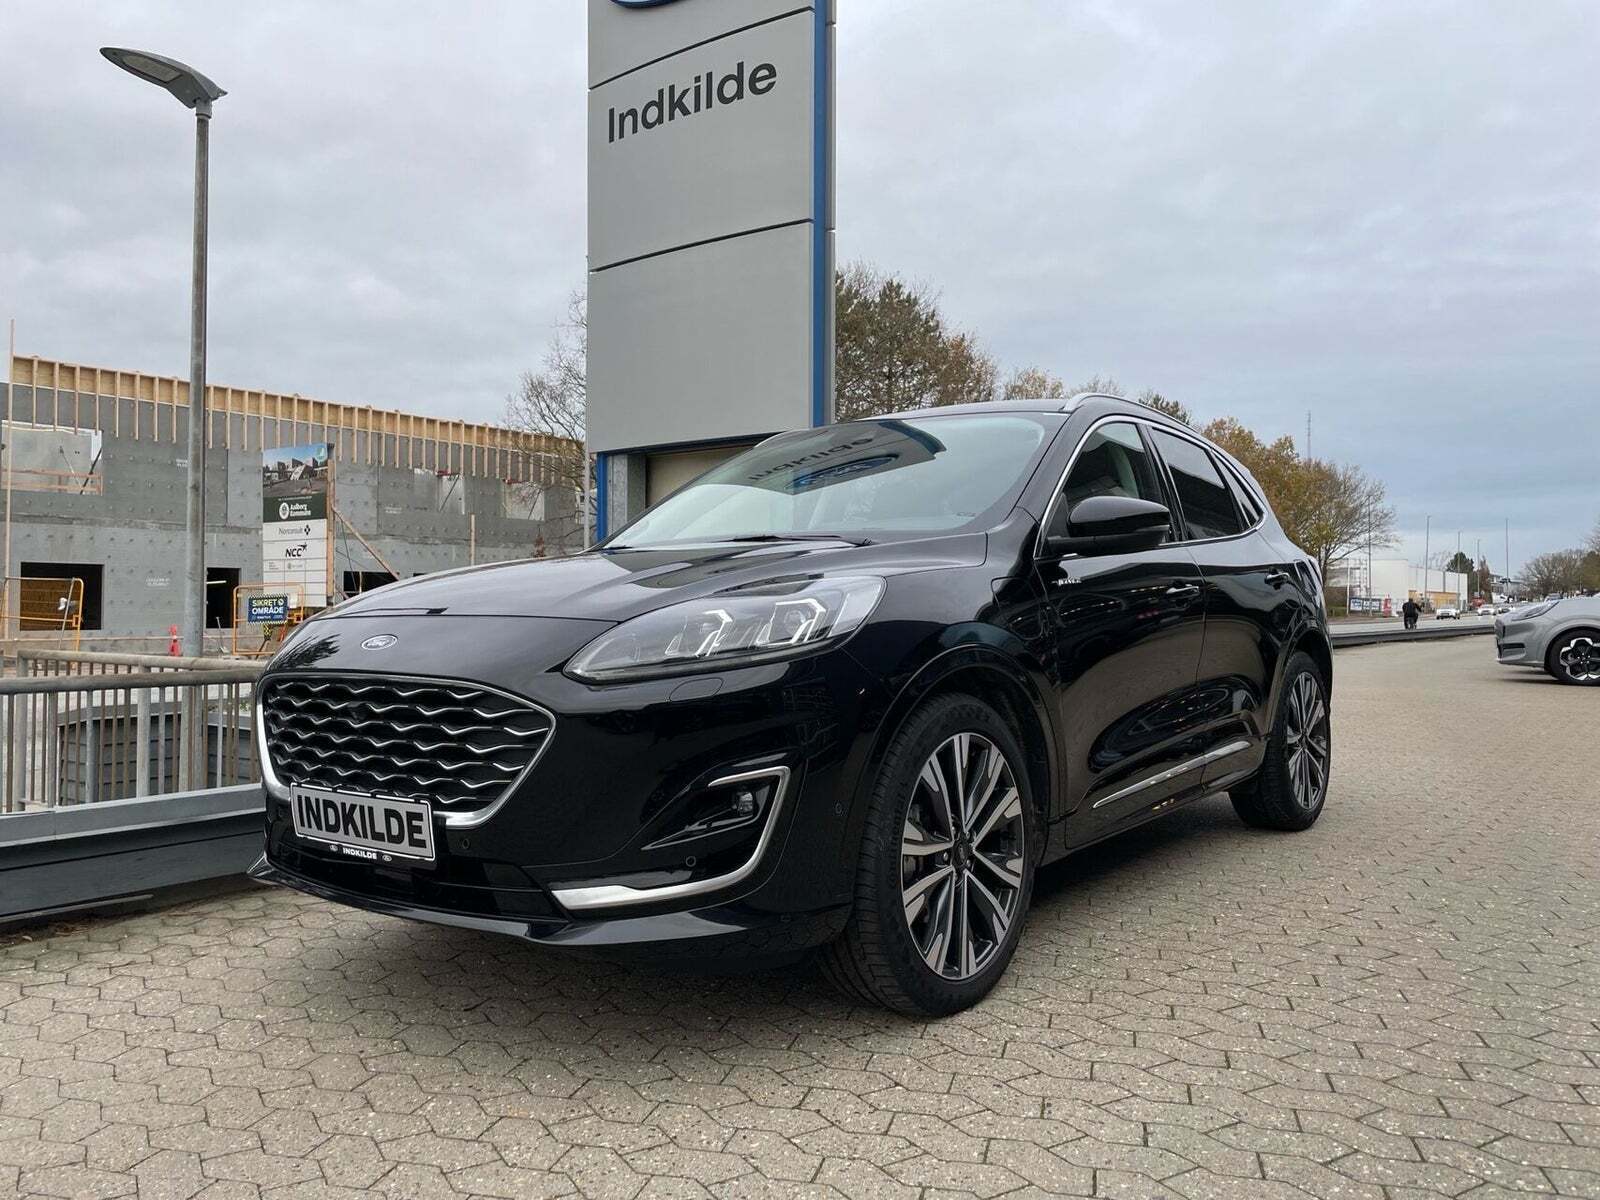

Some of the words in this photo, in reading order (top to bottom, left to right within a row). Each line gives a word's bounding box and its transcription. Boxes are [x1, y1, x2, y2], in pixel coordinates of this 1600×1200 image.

[609, 61, 777, 143] Indkilde
[285, 548, 302, 557] NCC
[252, 599, 278, 607] SIKRET
[297, 795, 427, 849] INDKILDE
[342, 847, 377, 860] INDKILDE
